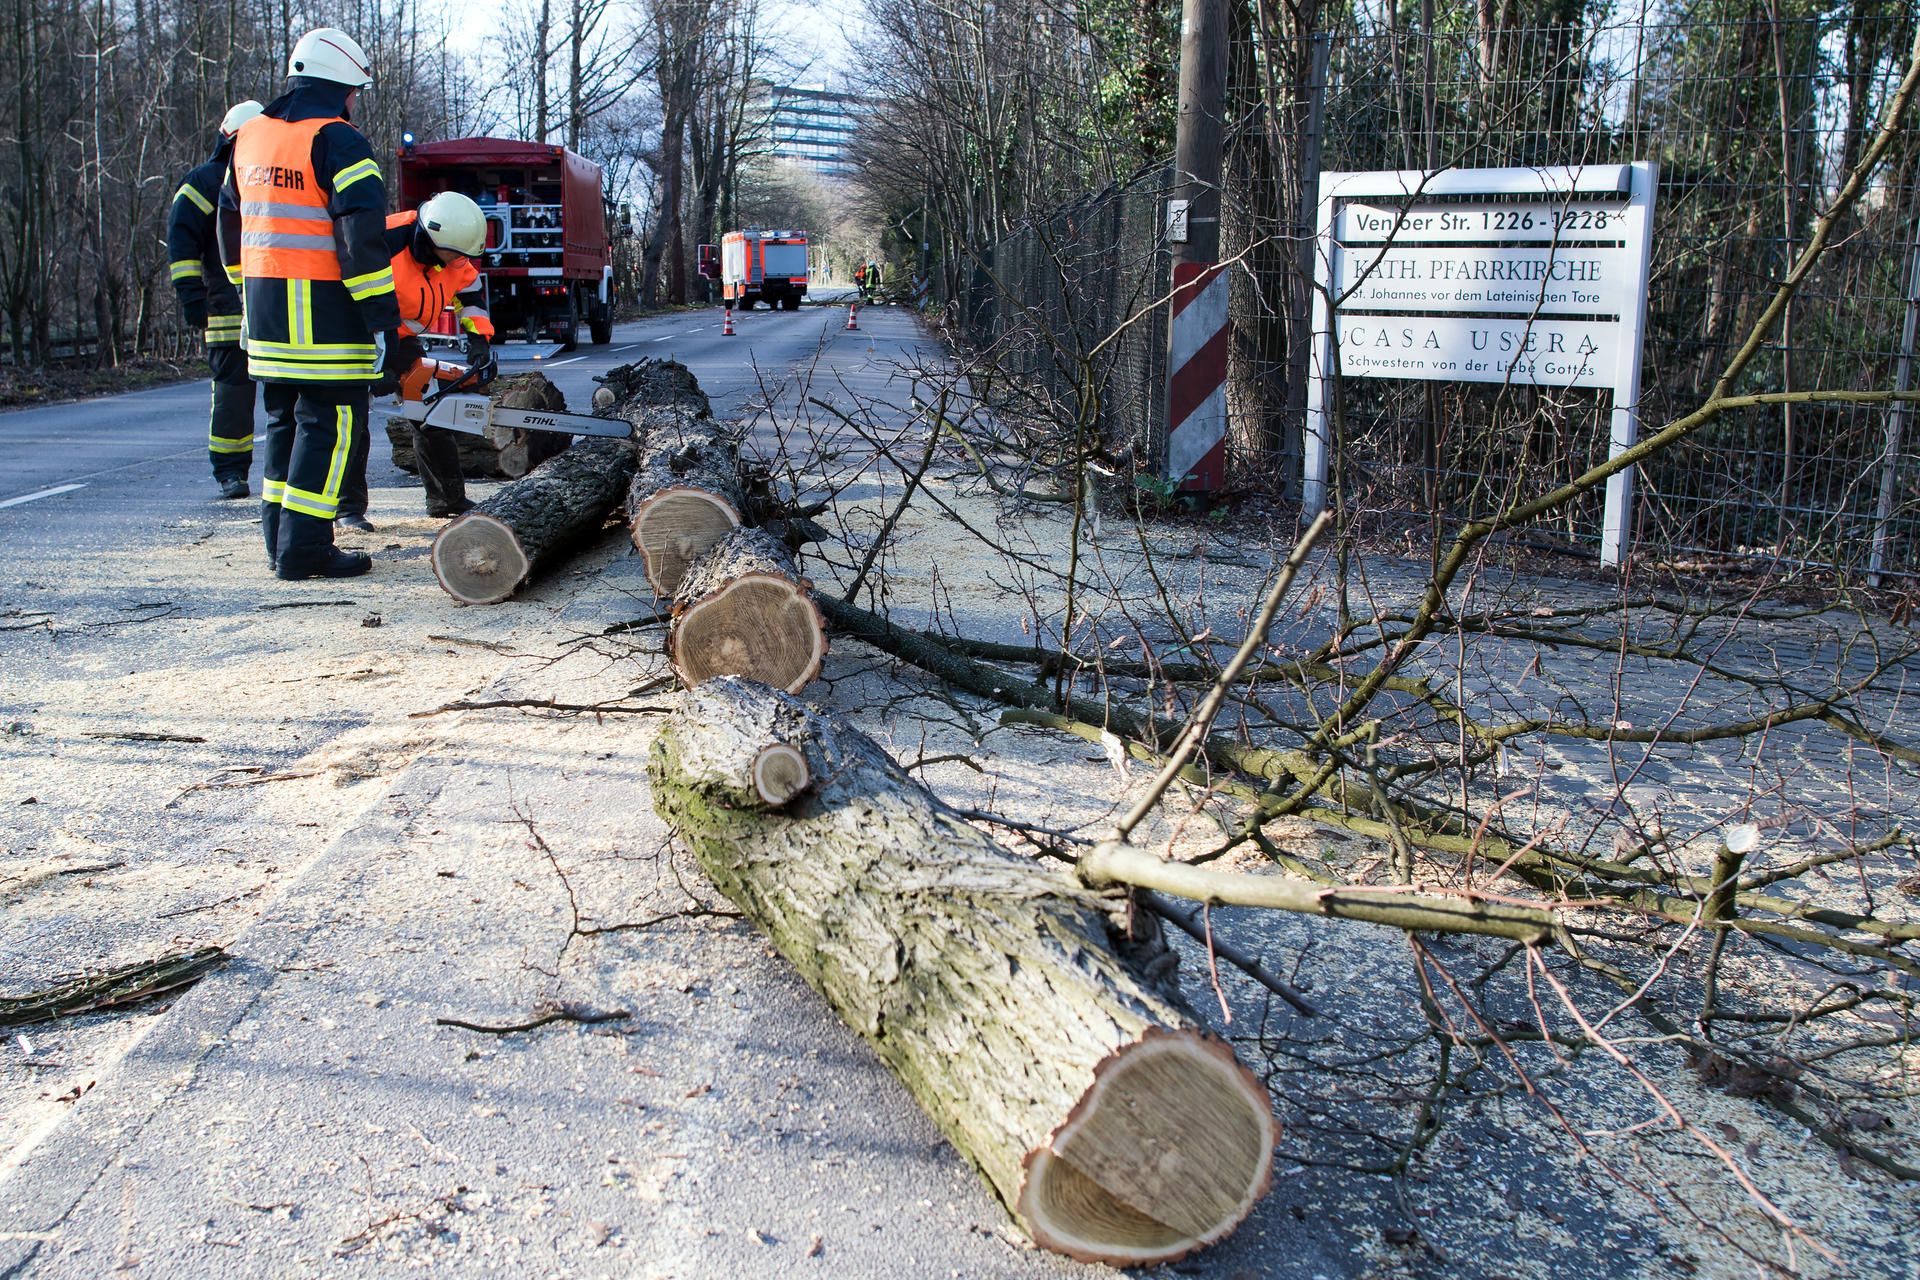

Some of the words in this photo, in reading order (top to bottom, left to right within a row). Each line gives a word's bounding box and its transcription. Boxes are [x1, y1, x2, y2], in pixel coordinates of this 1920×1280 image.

[237, 166, 305, 191] RWEHR
[1356, 210, 1433, 231] Venloer
[1440, 212, 1471, 231] Str.
[1353, 259, 1422, 280] KATH.
[1429, 259, 1602, 281] PFARRKIRCHE
[1352, 288, 1366, 299] St.
[1370, 287, 1427, 300] Johannes
[1430, 290, 1450, 300] vor
[1454, 289, 1482, 301] dem
[1571, 290, 1600, 303] Tore
[1350, 326, 1441, 349] CASA
[1470, 329, 1597, 354] USERA
[1348, 354, 1424, 369] Schwestern
[1432, 360, 1457, 370] von
[1465, 359, 1489, 371] der
[1545, 362, 1595, 376] Gottes
[522, 415, 556, 426] STIHL
